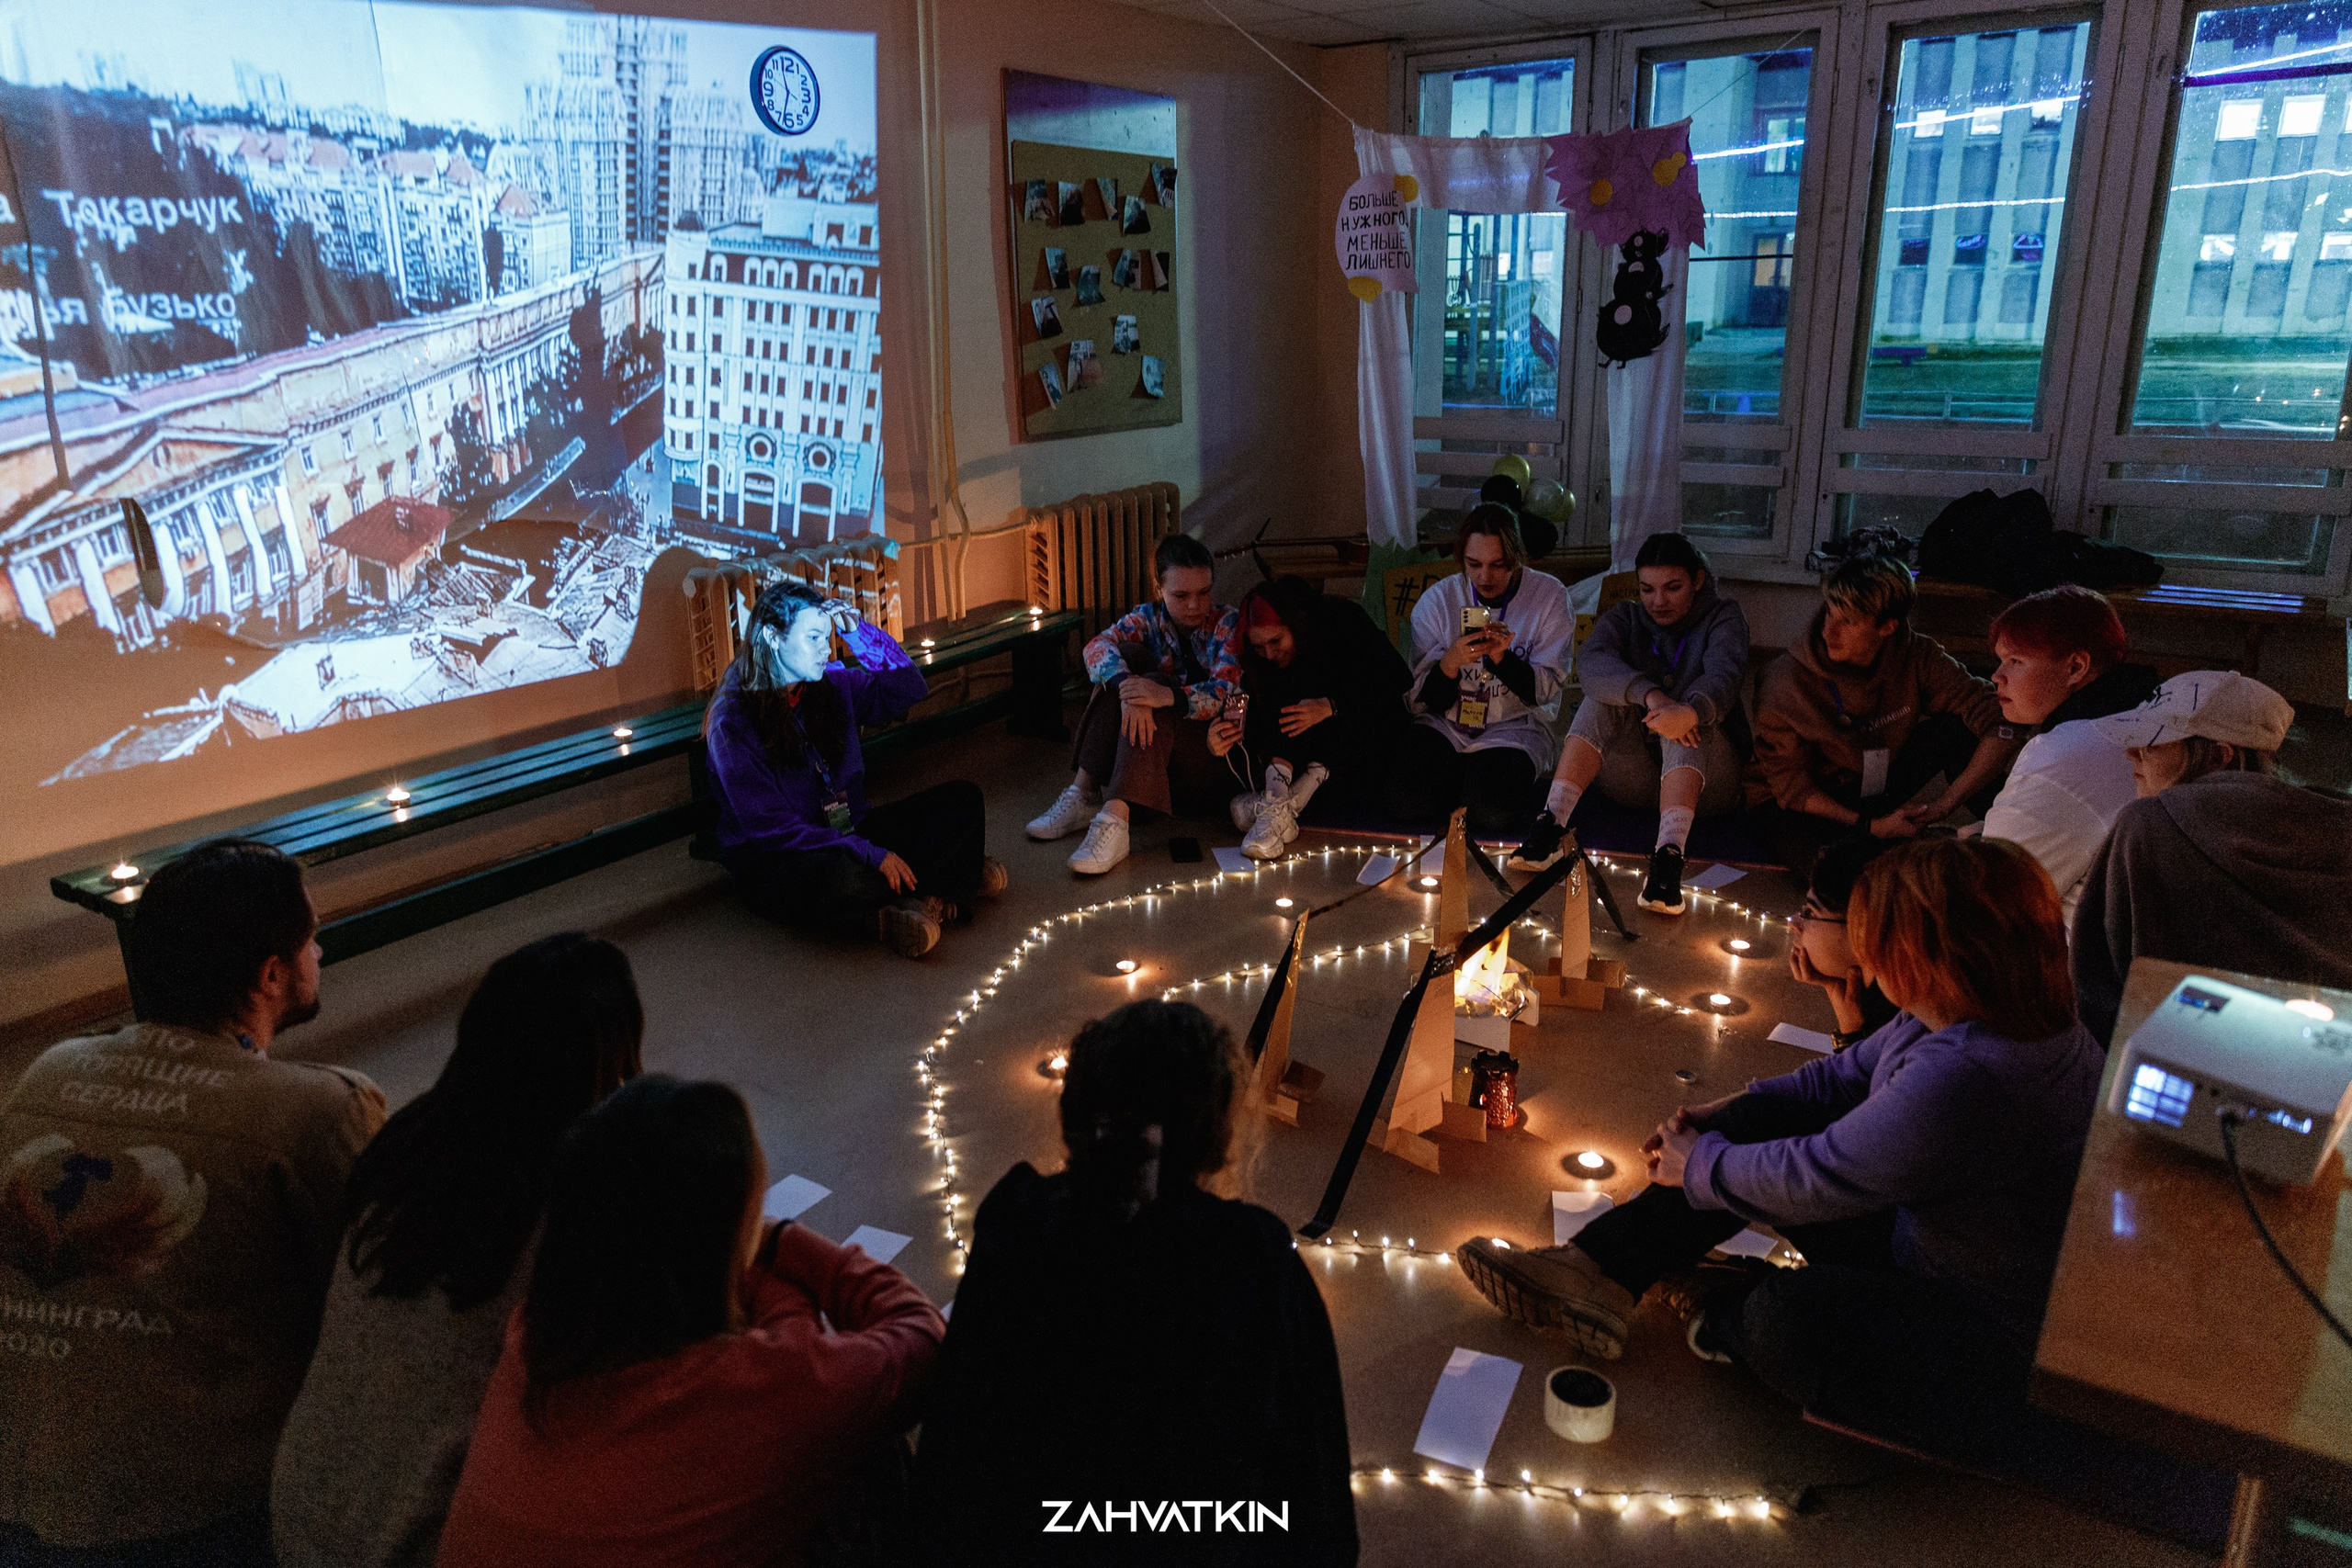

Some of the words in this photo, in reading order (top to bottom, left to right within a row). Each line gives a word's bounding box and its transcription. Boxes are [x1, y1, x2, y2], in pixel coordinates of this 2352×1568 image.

[772, 59, 779, 71] 11
[780, 56, 795, 73] 12
[796, 62, 800, 75] 1
[764, 68, 774, 80] 10
[800, 74, 808, 86] 2
[763, 81, 774, 97] 9
[801, 87, 811, 104] 3
[767, 99, 775, 111] 8
[802, 105, 809, 117] 4
[775, 110, 782, 123] 7
[784, 113, 795, 129] 6
[796, 114, 804, 126] 5
[1349, 190, 1399, 211] БОЛЬШЕ
[41, 187, 243, 235] Токарчук
[1347, 231, 1408, 253] МЕНЬШЕ
[1346, 251, 1411, 270] ЛИШНЕГО
[0, 1293, 174, 1337] НИНГРАД
